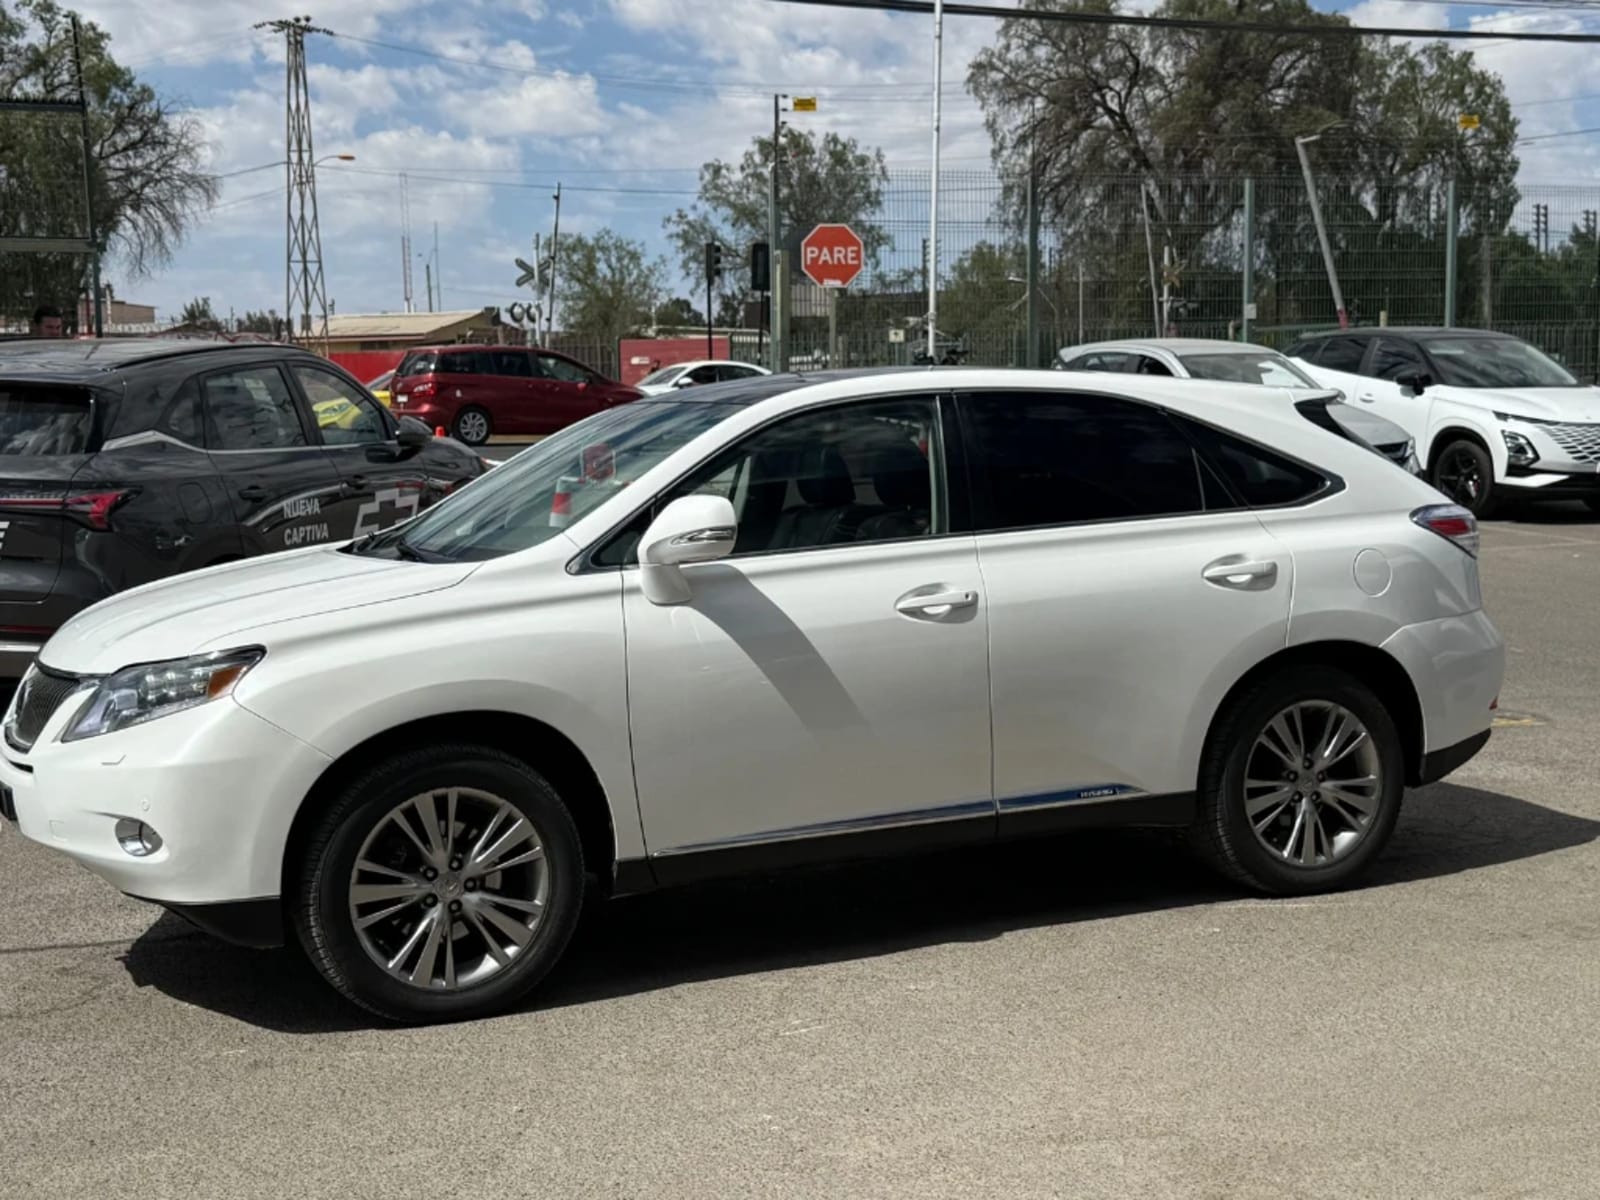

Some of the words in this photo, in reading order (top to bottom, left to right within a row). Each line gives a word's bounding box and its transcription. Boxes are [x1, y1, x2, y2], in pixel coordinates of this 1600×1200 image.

[806, 246, 859, 265] PARE
[283, 498, 321, 519] NUEVA
[284, 523, 329, 545] CAPTIVA
